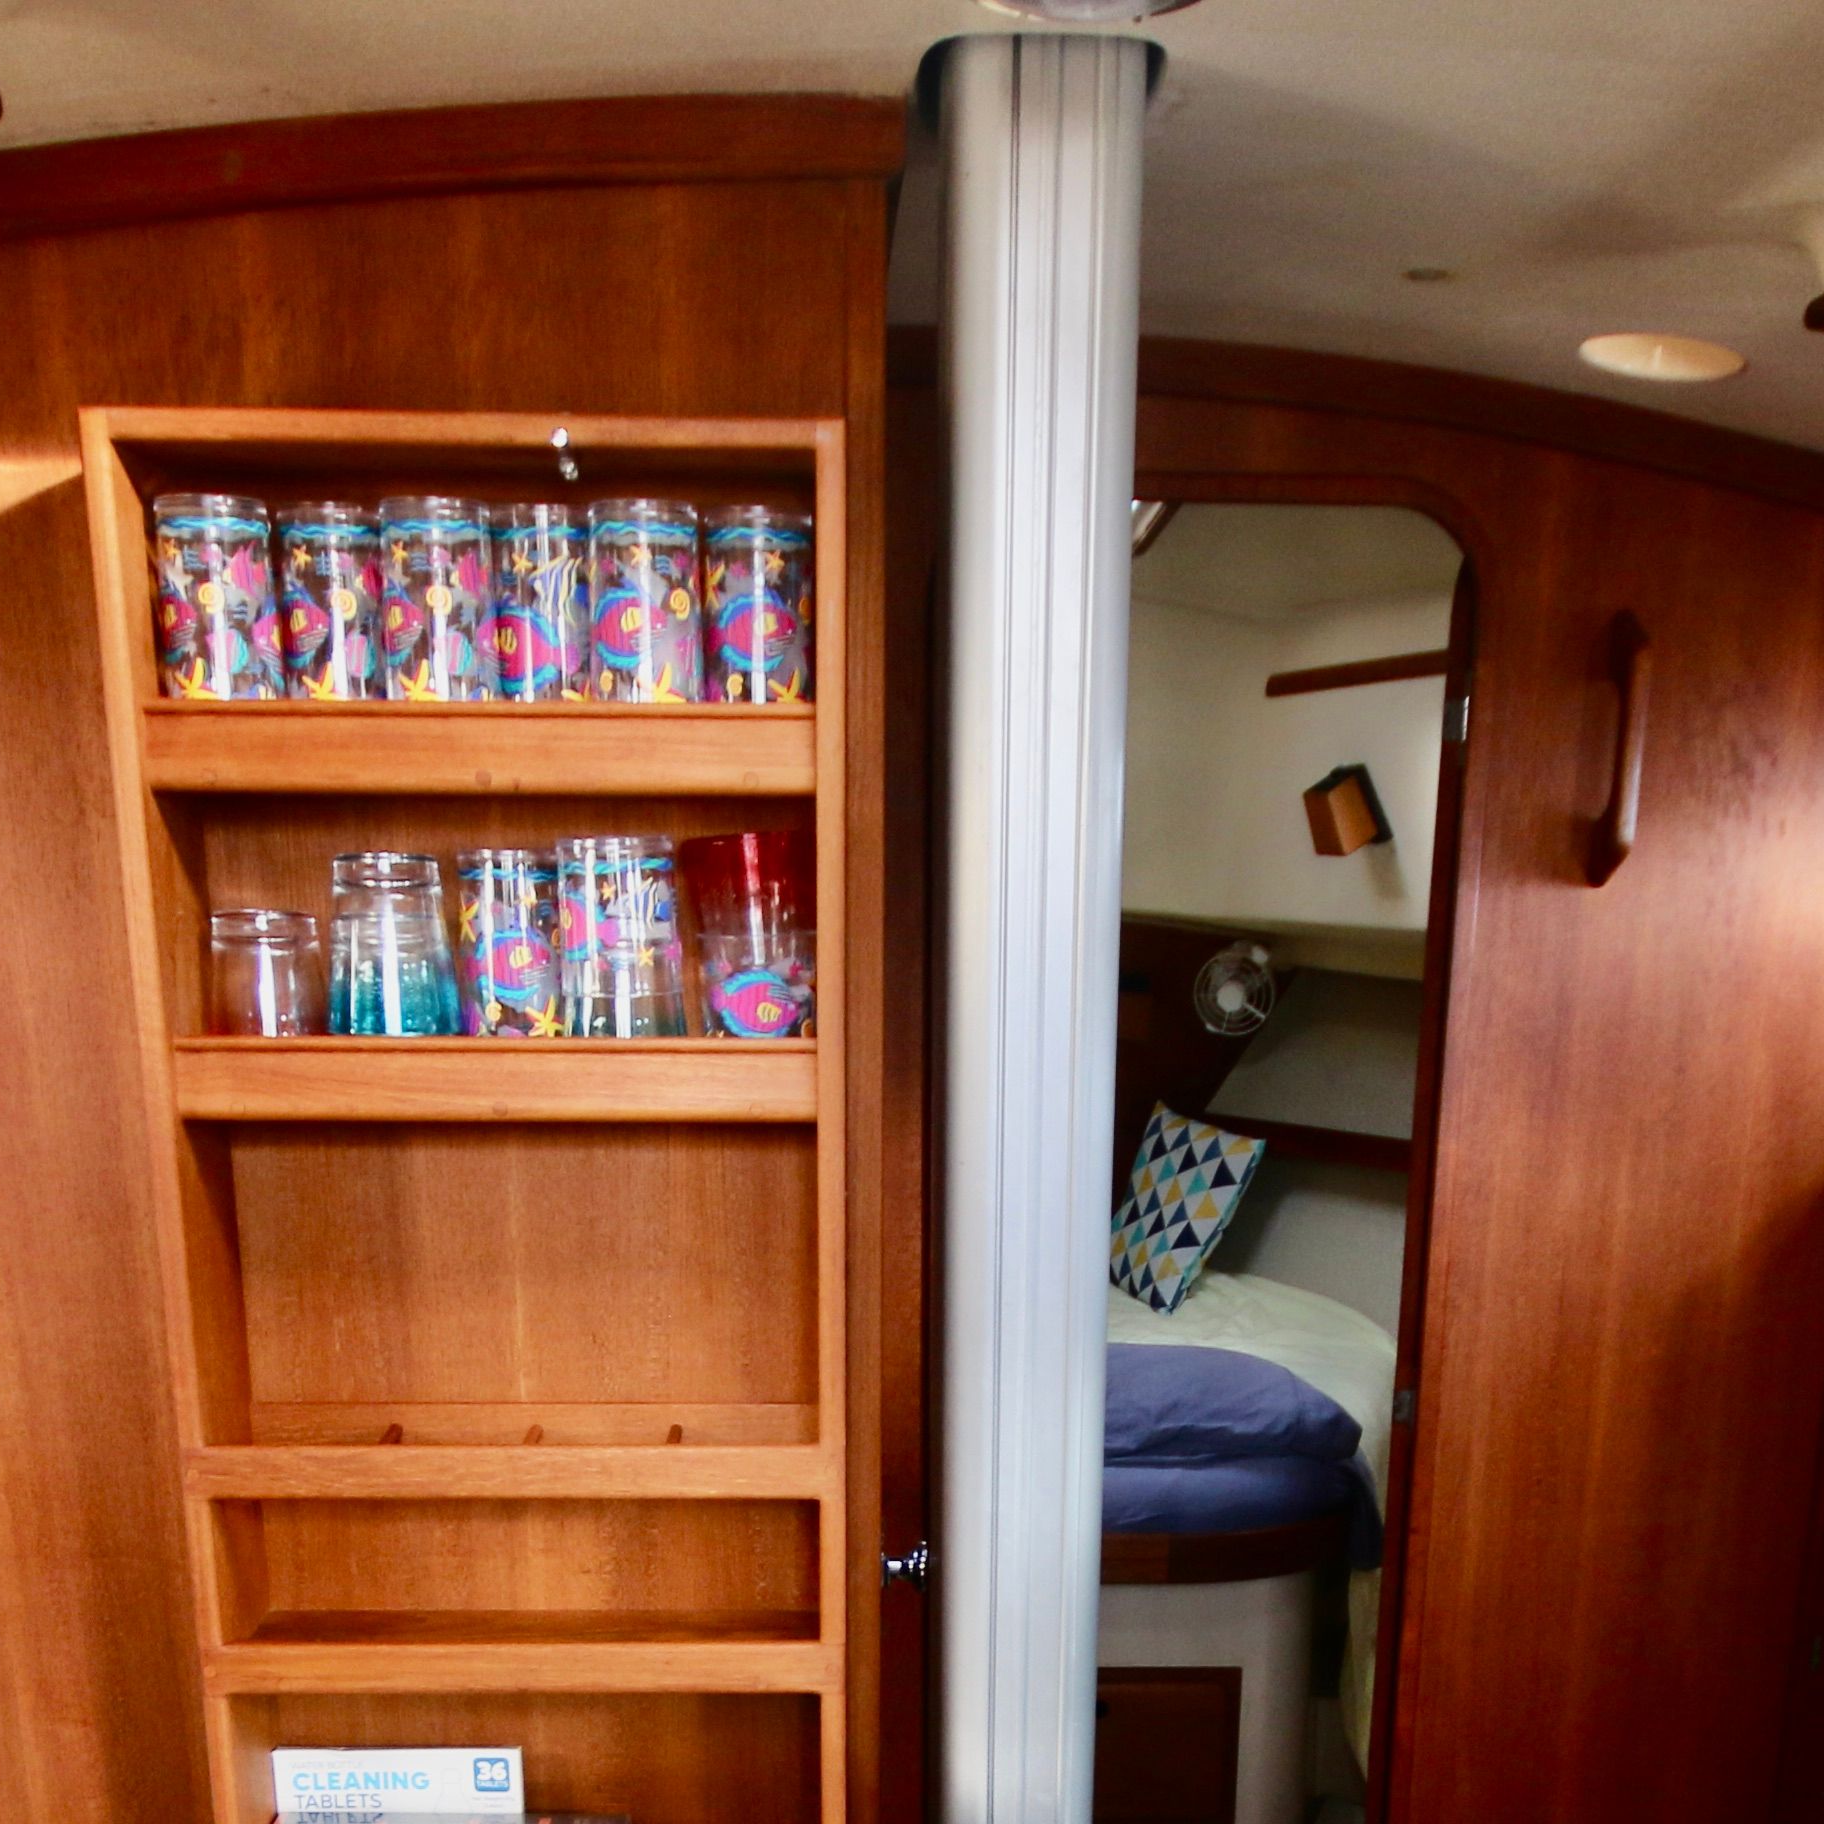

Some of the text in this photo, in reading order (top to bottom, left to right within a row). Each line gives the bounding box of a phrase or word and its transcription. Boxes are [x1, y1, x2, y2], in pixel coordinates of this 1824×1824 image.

[476, 1761, 507, 1780] 36
[292, 1771, 430, 1791] CLEANING
[295, 1793, 382, 1809] TABLETS
